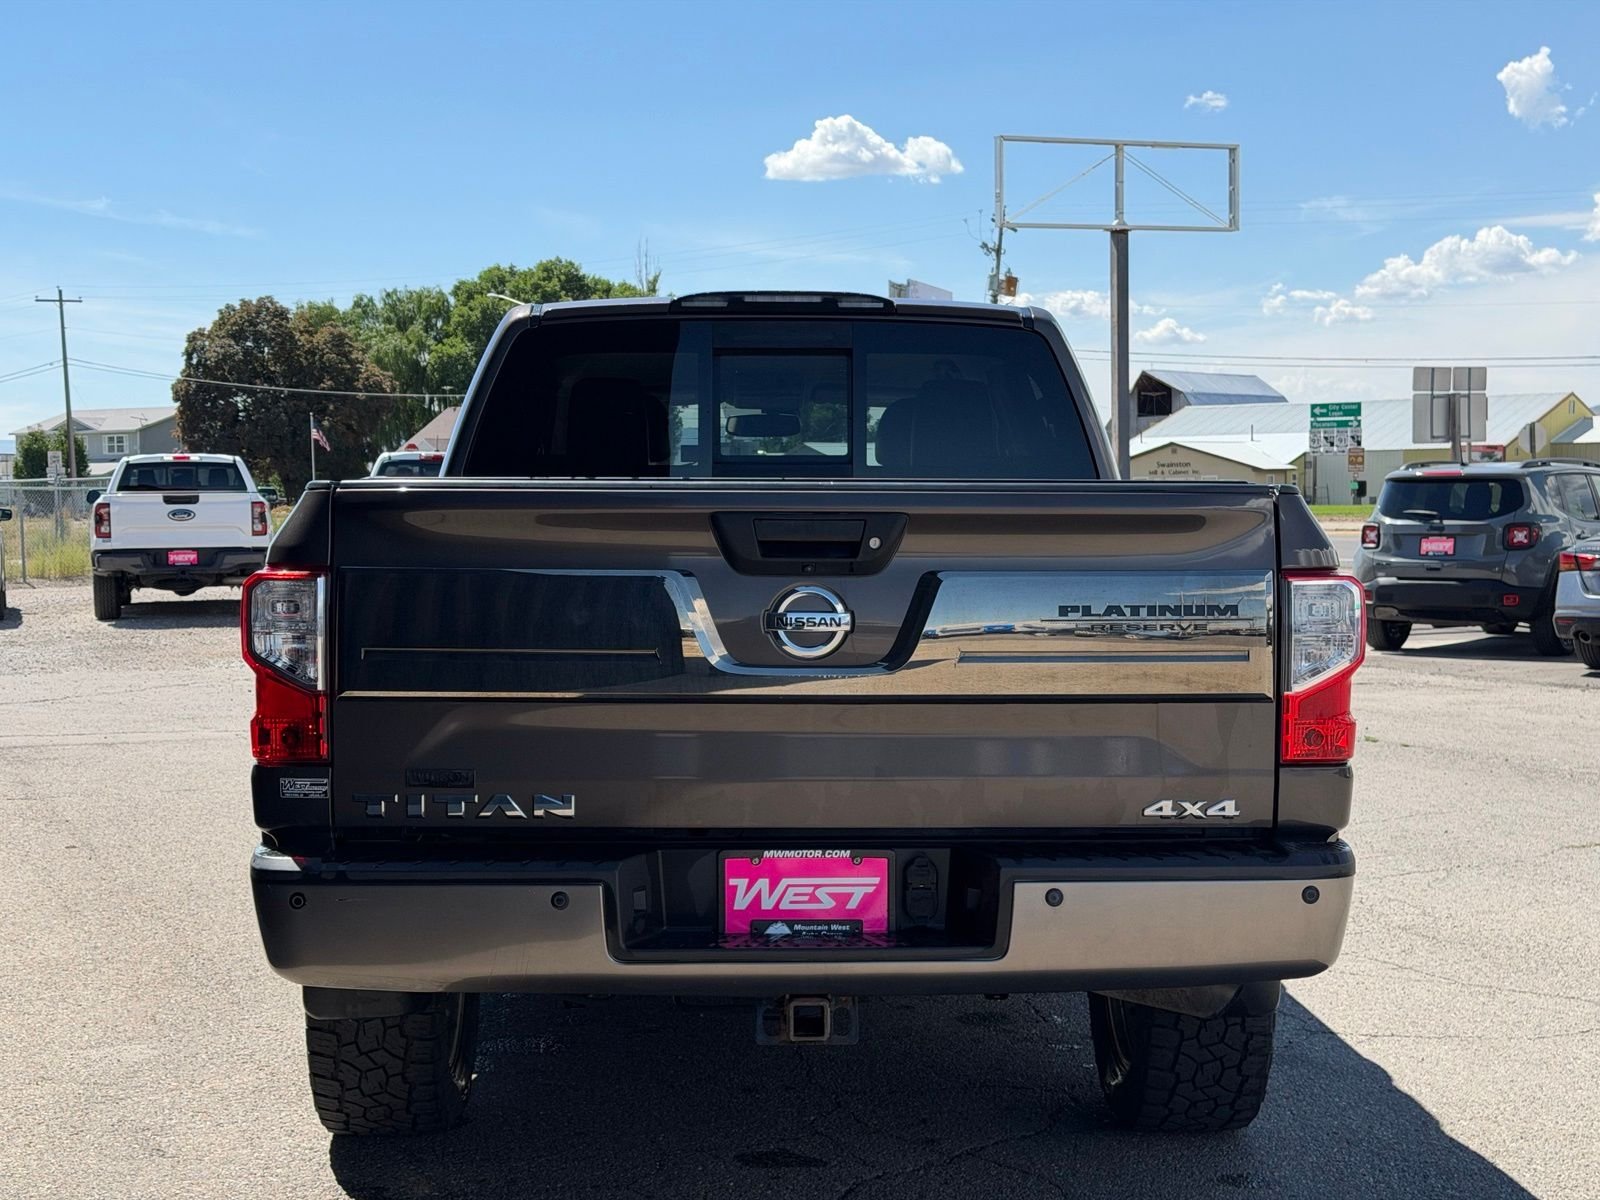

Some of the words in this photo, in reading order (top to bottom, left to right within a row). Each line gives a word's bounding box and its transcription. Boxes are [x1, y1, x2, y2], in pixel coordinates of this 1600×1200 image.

[1058, 604, 1239, 617] PLATINUM
[775, 617, 842, 628] NISSAN
[1091, 623, 1208, 631] RESERVE
[352, 793, 576, 819] TITAN
[763, 849, 851, 859] MWMOTOR.COM
[793, 923, 828, 931] Mountain
[830, 923, 850, 931] West
